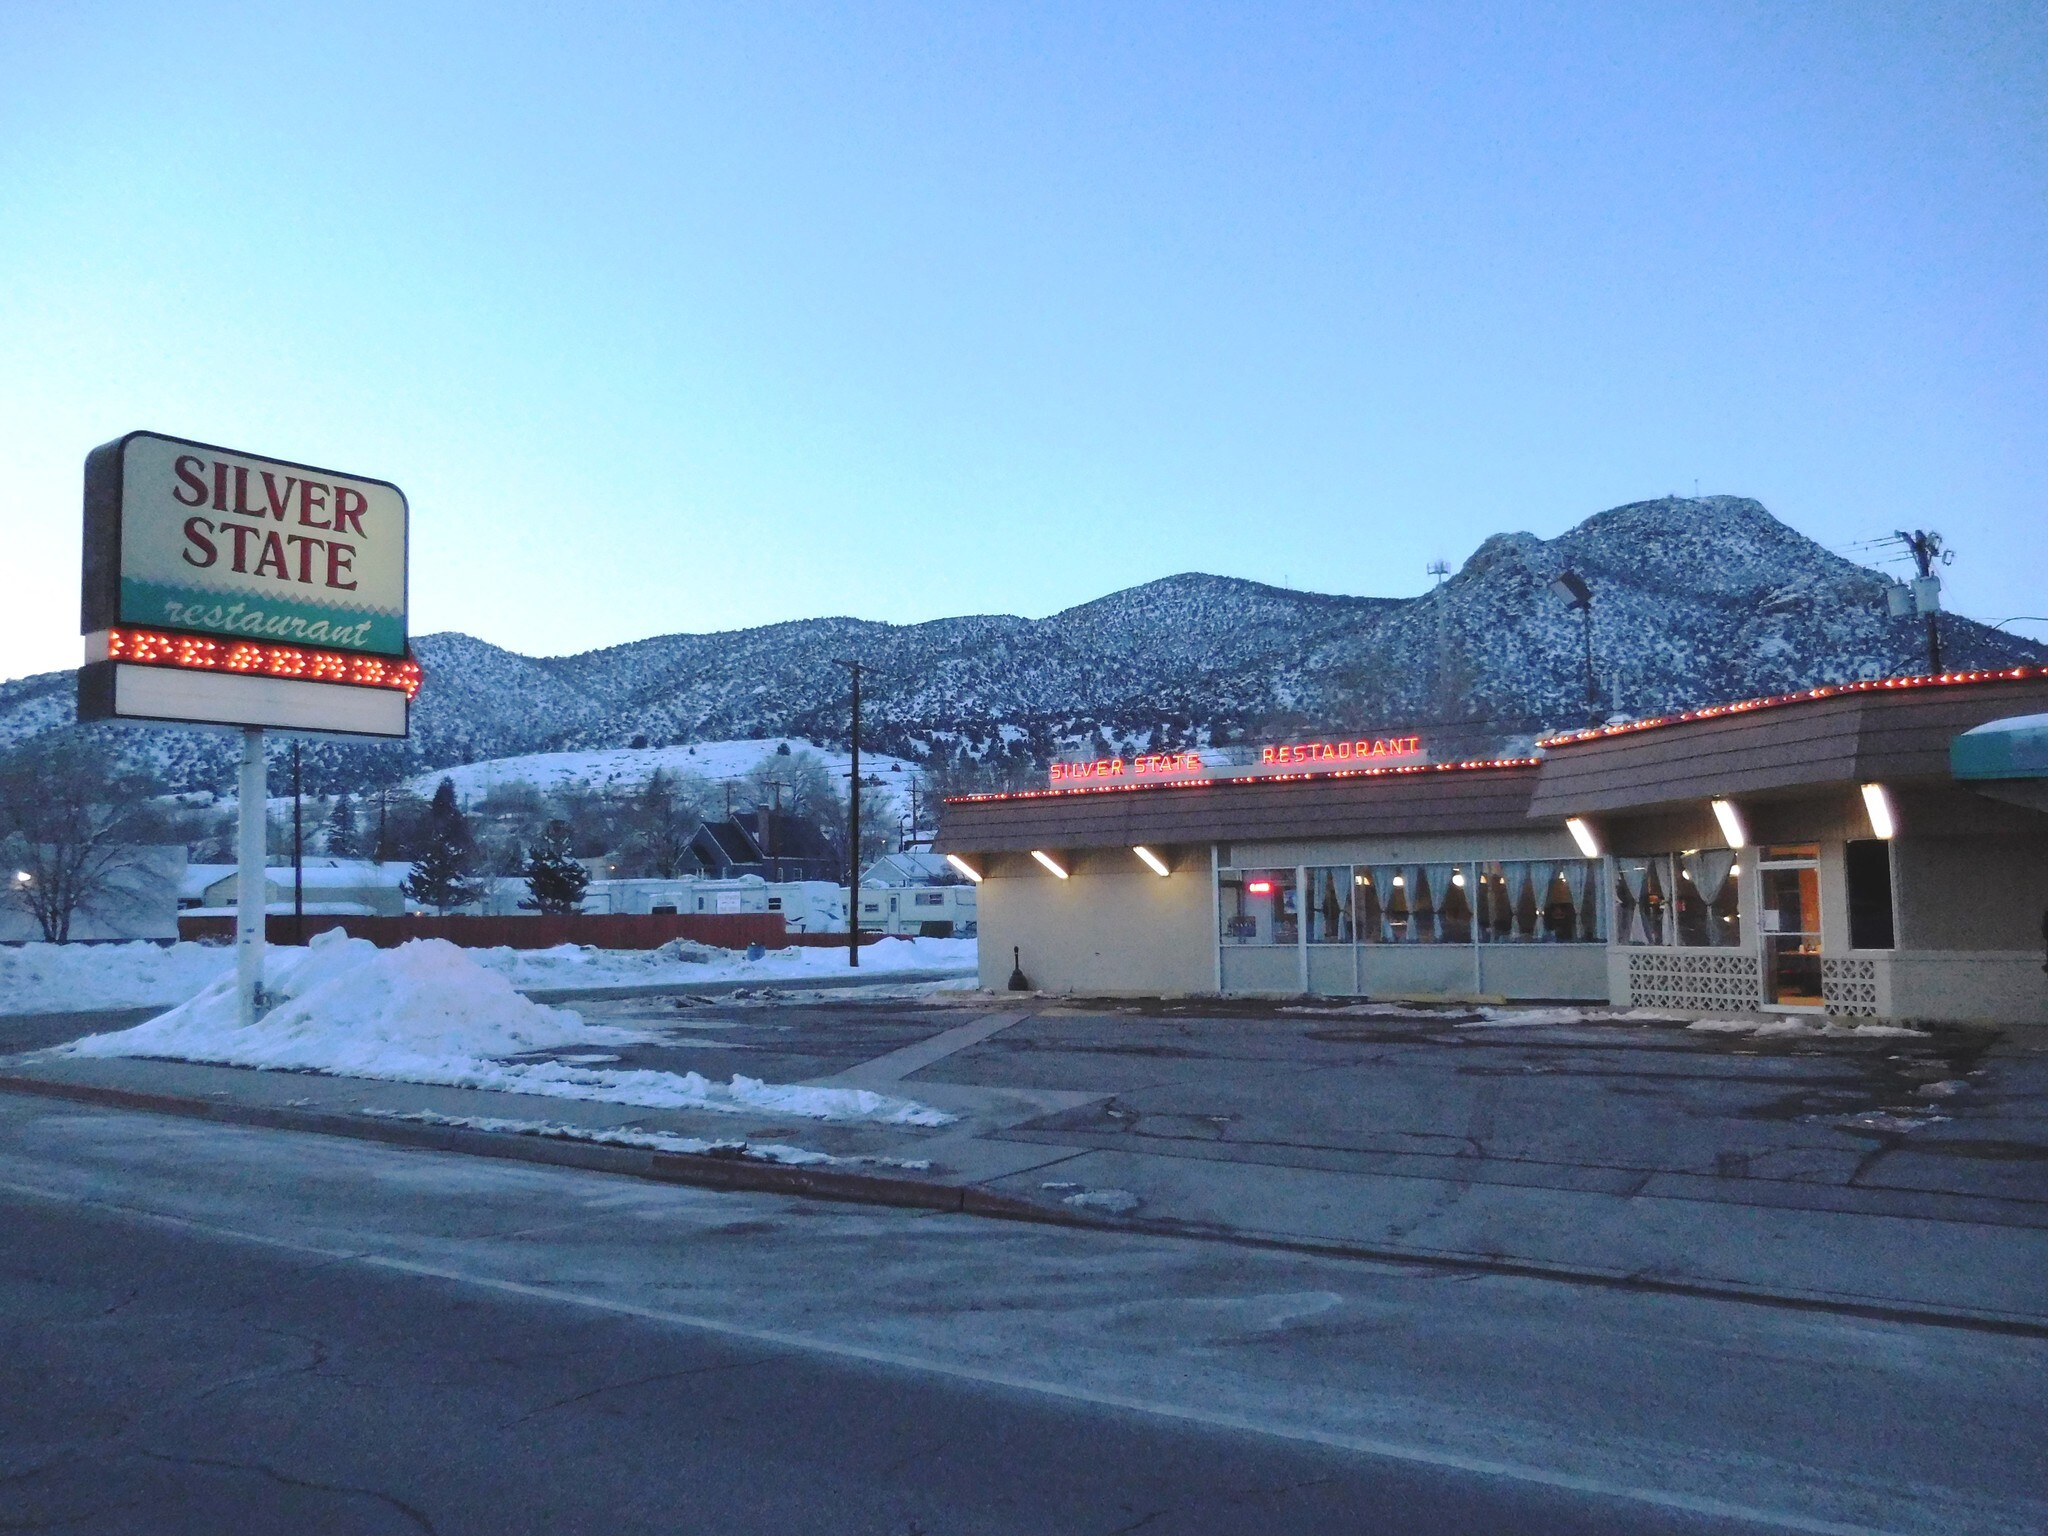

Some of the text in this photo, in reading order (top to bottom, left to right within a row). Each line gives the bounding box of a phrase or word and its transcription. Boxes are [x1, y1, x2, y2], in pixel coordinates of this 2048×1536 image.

[173, 455, 368, 539] SILVER
[182, 516, 358, 591] STATE
[165, 601, 372, 647] restaurant
[1050, 737, 1419, 780] SILVER STATE RESTAURANT
